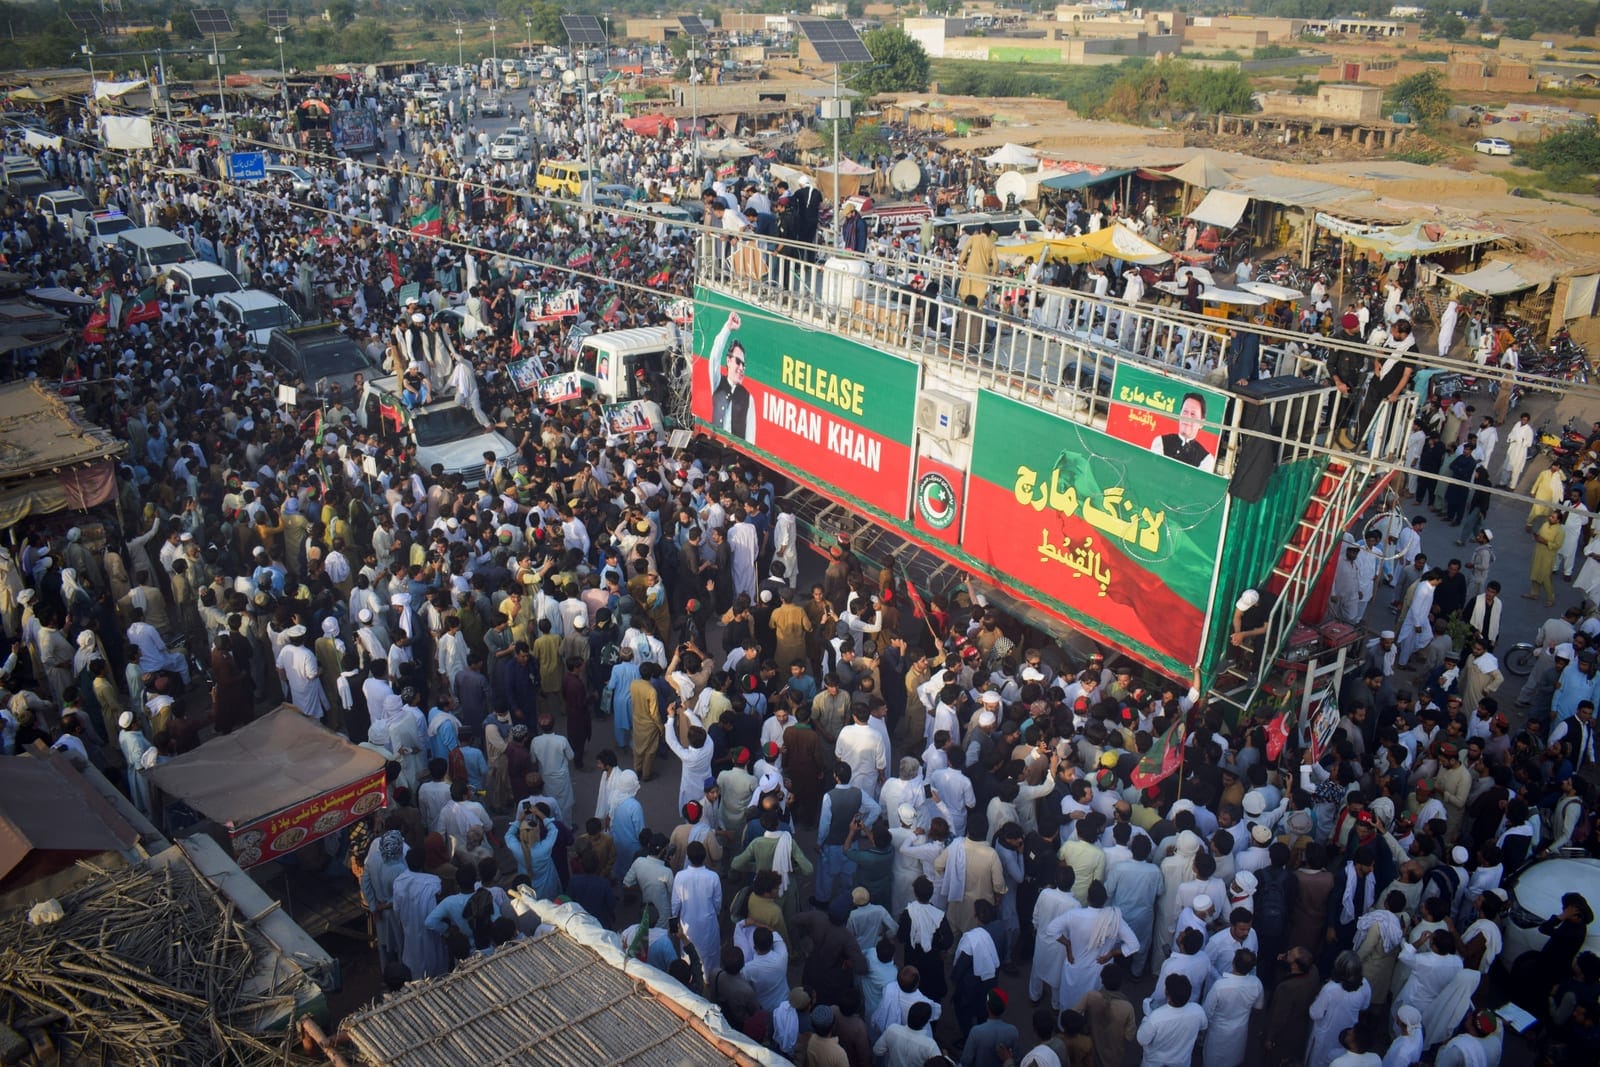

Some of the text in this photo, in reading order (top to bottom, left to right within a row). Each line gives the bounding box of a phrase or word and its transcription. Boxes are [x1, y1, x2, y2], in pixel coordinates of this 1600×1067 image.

[782, 355, 864, 416] RELEASE
[1120, 385, 1175, 413] لانگ مارچ
[763, 391, 881, 472] IMRAN KHAN
[1015, 466, 1078, 517] مارچ
[1083, 487, 1165, 553] لانگ
